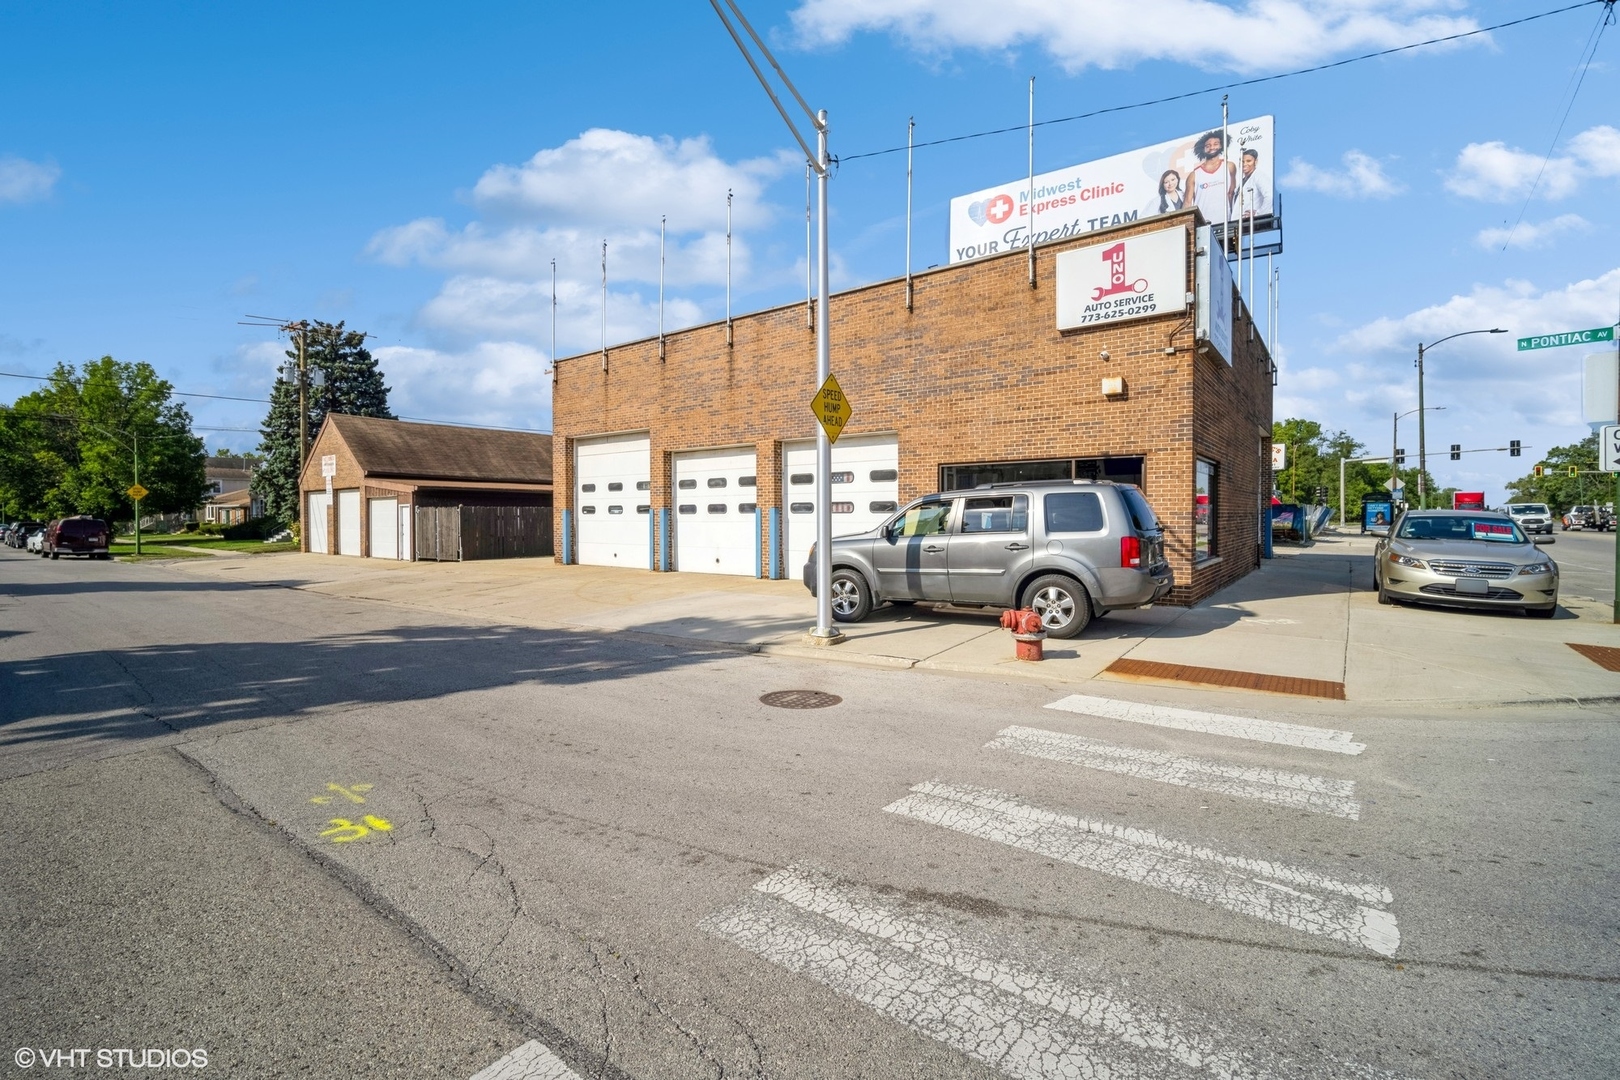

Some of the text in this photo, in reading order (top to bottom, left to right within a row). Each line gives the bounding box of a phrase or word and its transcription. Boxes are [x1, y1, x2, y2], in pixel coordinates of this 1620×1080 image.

[1240, 125, 1260, 135] Coby
[1020, 177, 1082, 203] Midwest
[1020, 182, 1124, 216] Express Clinic
[956, 209, 1138, 261] YOUR Expert TEAM
[1112, 251, 1124, 285] UNO
[1084, 293, 1154, 313] AUTO SERVICE
[1081, 303, 1157, 323] 773-625-0299
[1531, 331, 1592, 348] PONTIAC
[1597, 330, 1608, 338] AV
[822, 388, 842, 402] SPEED
[824, 401, 841, 413] HUMP
[823, 414, 843, 427] AHEAD
[1475, 523, 1512, 534] FOR SALE
